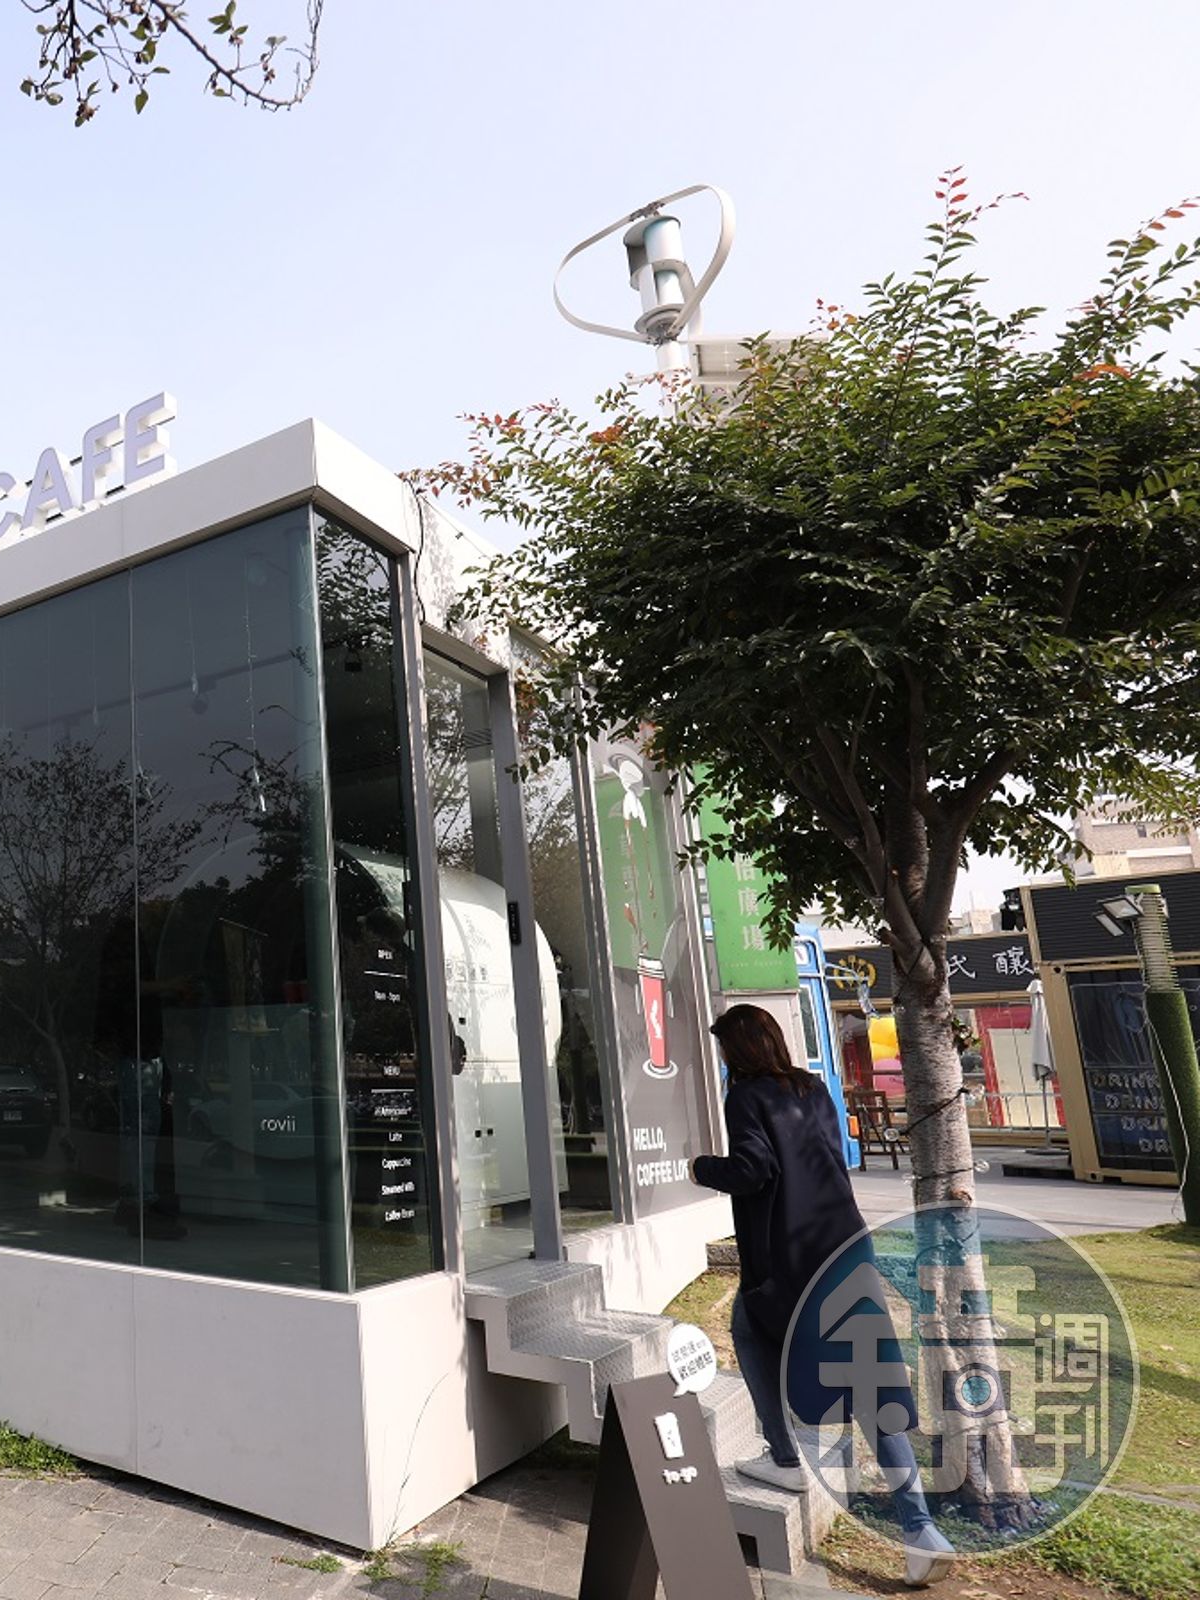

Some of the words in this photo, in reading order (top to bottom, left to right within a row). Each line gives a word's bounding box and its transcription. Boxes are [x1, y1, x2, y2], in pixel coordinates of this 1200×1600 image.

[260, 1115, 296, 1132] rovii
[633, 1126, 667, 1153] HELLO,
[636, 1160, 673, 1187] COFFEE
